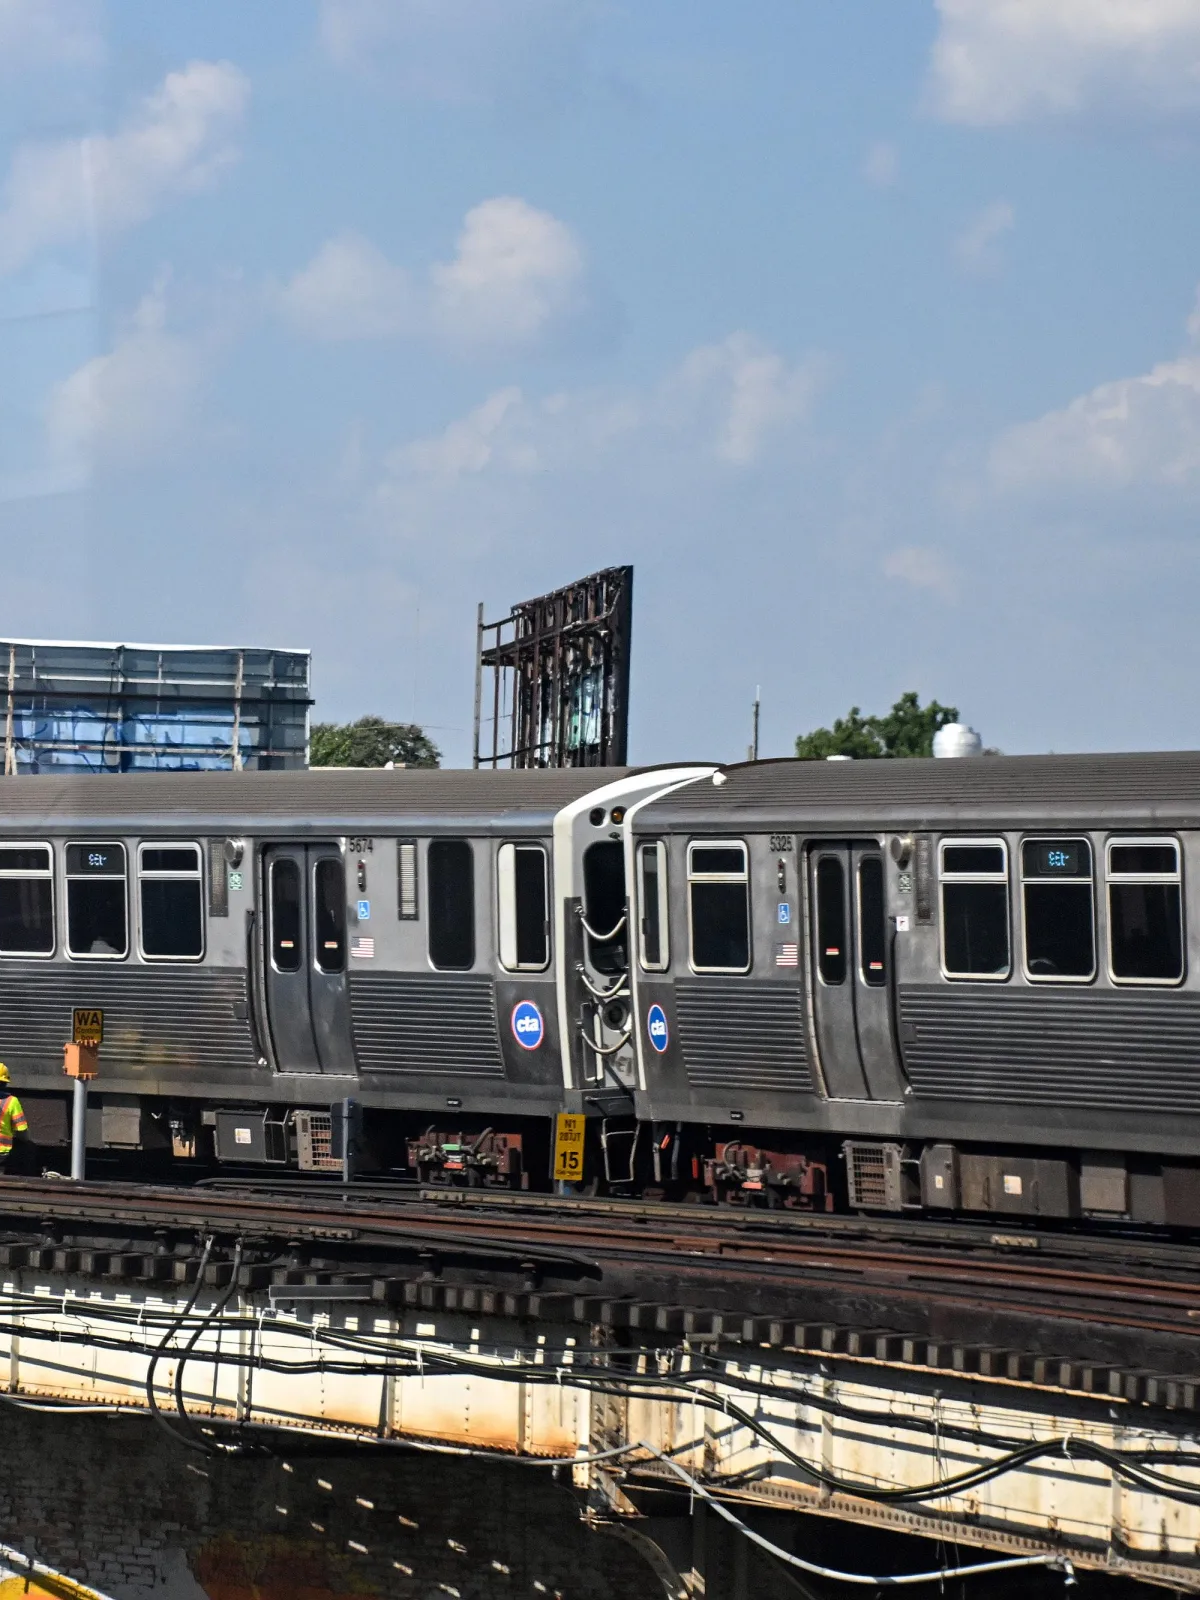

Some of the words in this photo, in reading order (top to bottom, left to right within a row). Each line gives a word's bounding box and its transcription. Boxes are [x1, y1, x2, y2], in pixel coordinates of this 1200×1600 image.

[349, 837, 374, 853] 5674
[770, 836, 793, 852] 5325
[76, 1011, 101, 1026] WA
[516, 1015, 540, 1033] cta
[650, 1019, 667, 1036] cta
[560, 1150, 580, 1169] 15
